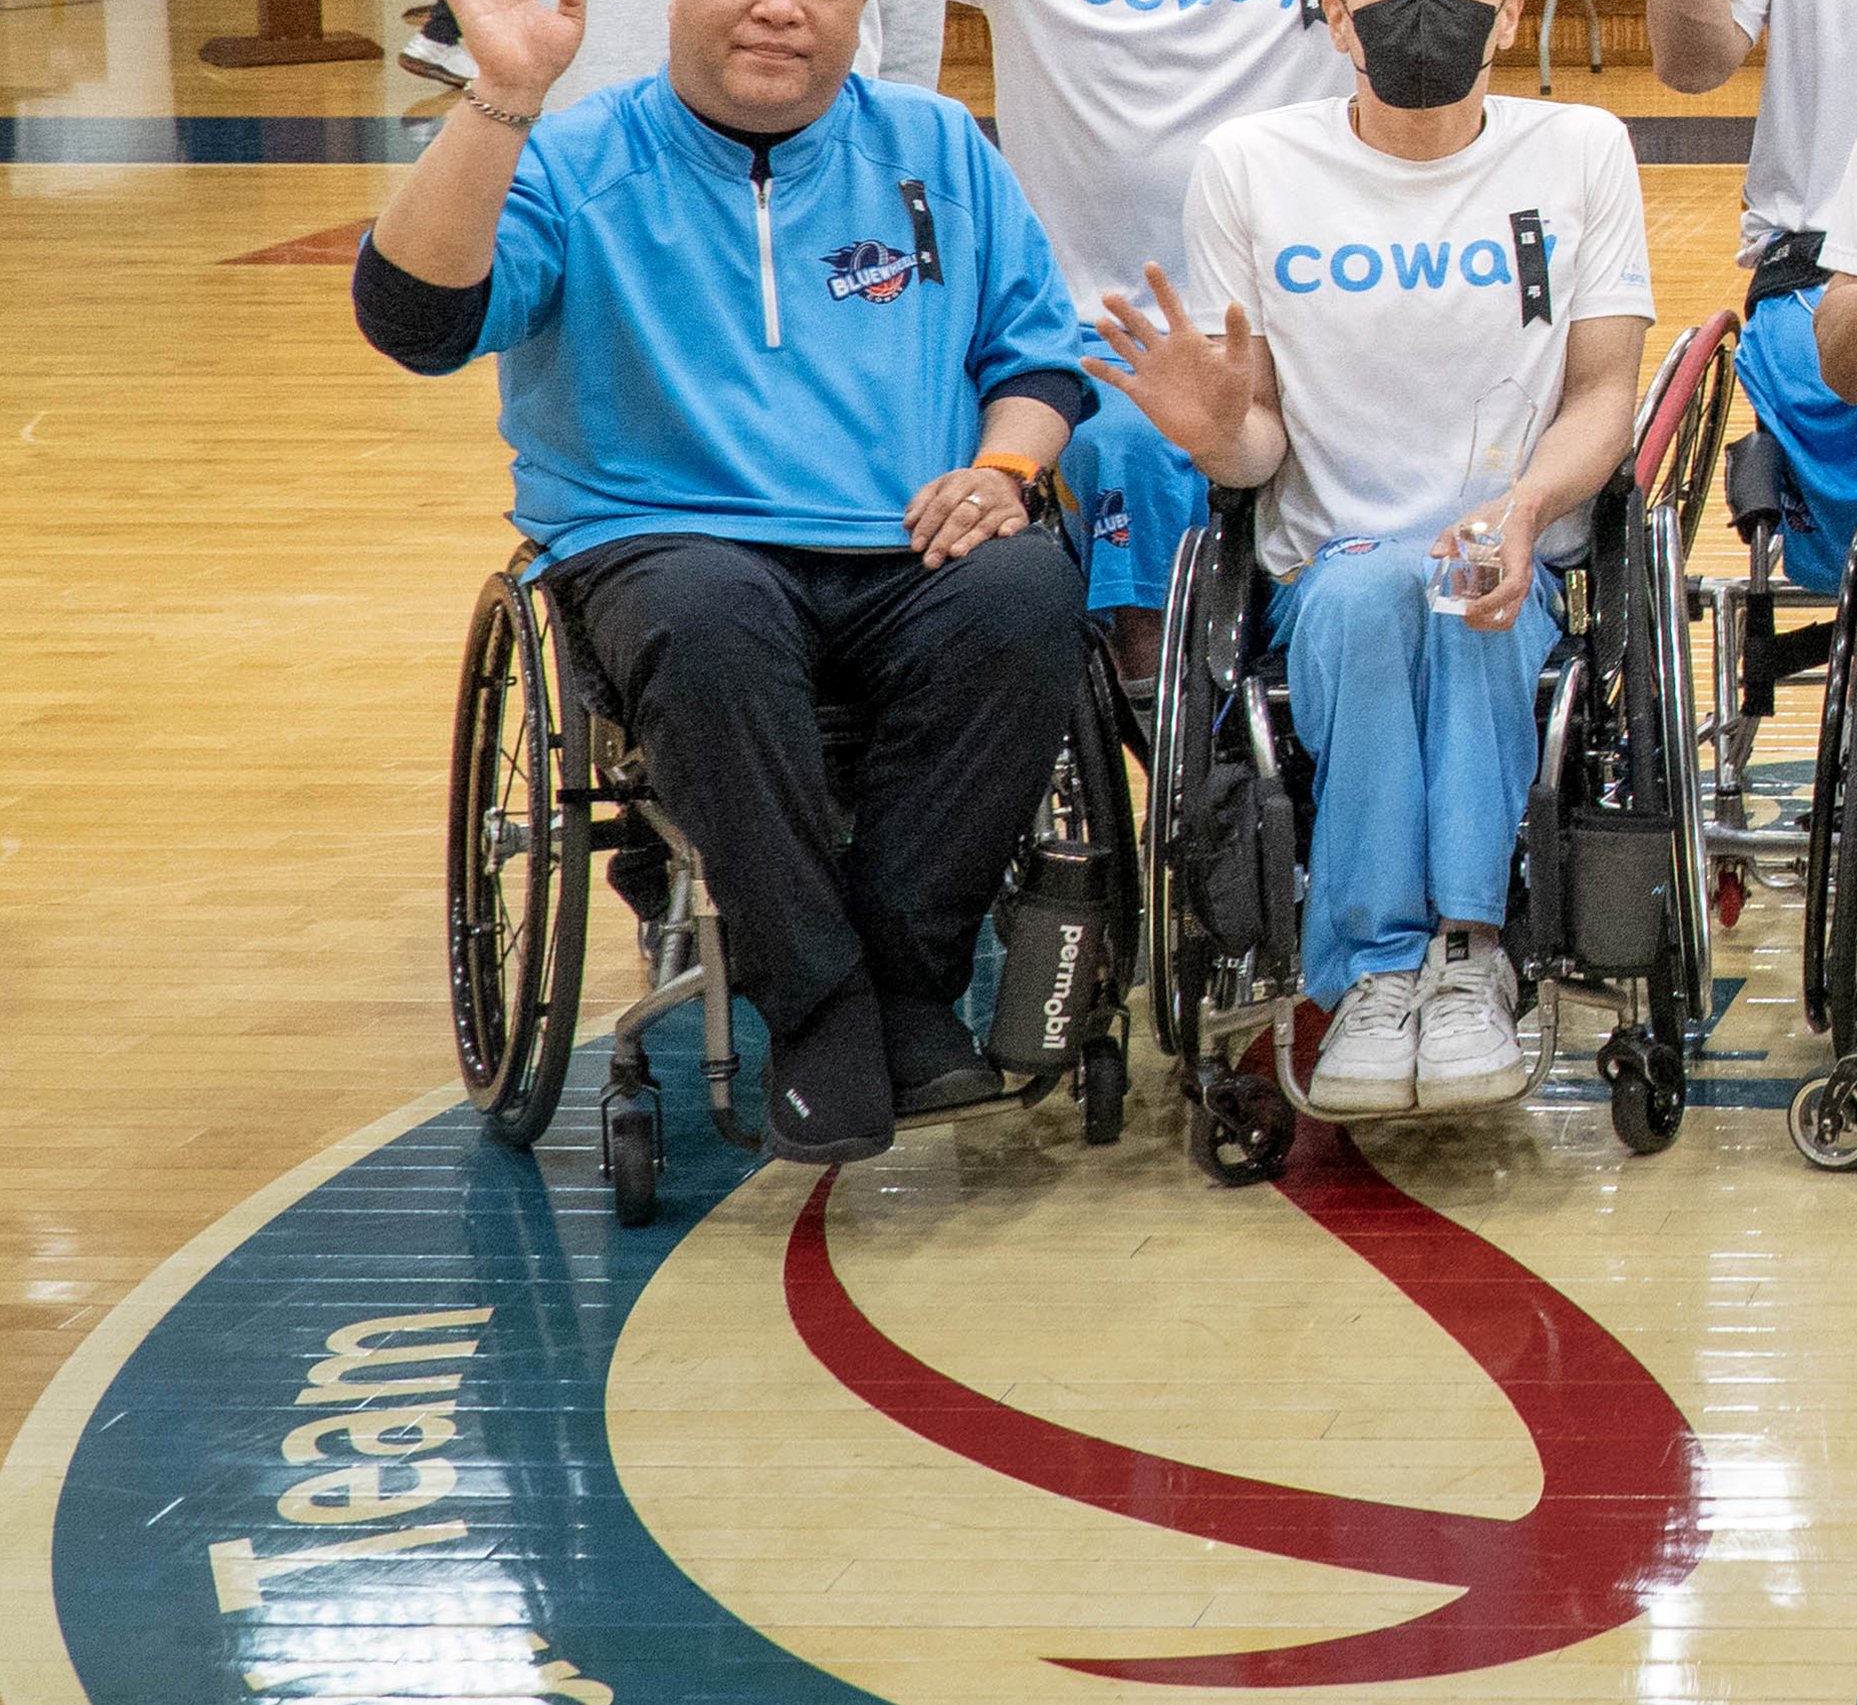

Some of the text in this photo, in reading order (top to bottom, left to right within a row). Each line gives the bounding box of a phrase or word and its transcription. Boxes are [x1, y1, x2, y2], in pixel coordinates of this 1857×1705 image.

[831, 253, 918, 298] BLUEWHEEL
[1042, 924, 1085, 1050] permobil
[207, 1306, 496, 1614] Team
